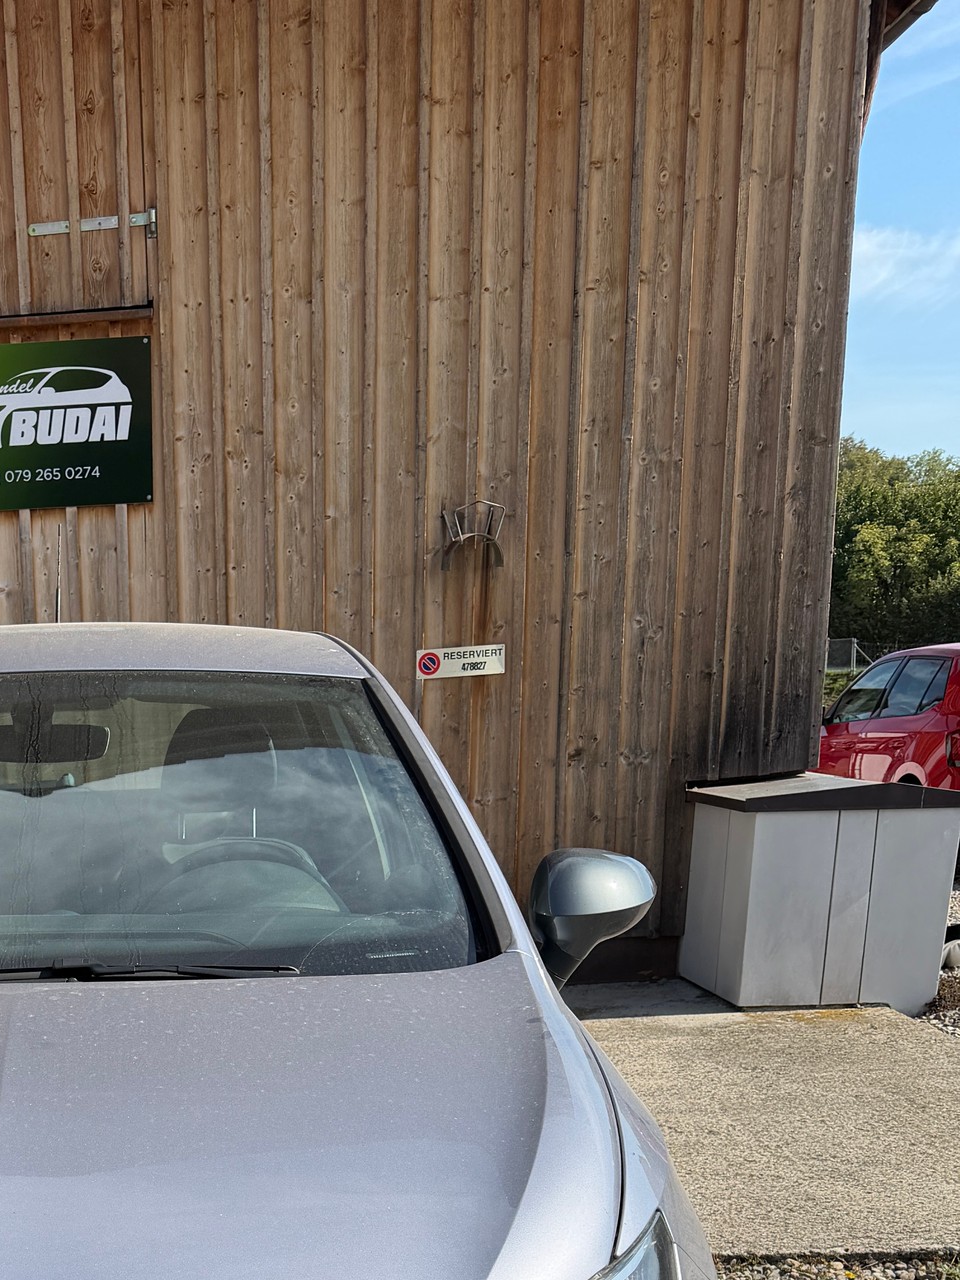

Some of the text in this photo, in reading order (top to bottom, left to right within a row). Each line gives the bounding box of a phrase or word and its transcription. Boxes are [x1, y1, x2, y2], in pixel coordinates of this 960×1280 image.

[9, 405, 133, 447] BUDAI
[5, 466, 101, 483] 079 265 0274
[443, 648, 503, 661] RESERVIERT
